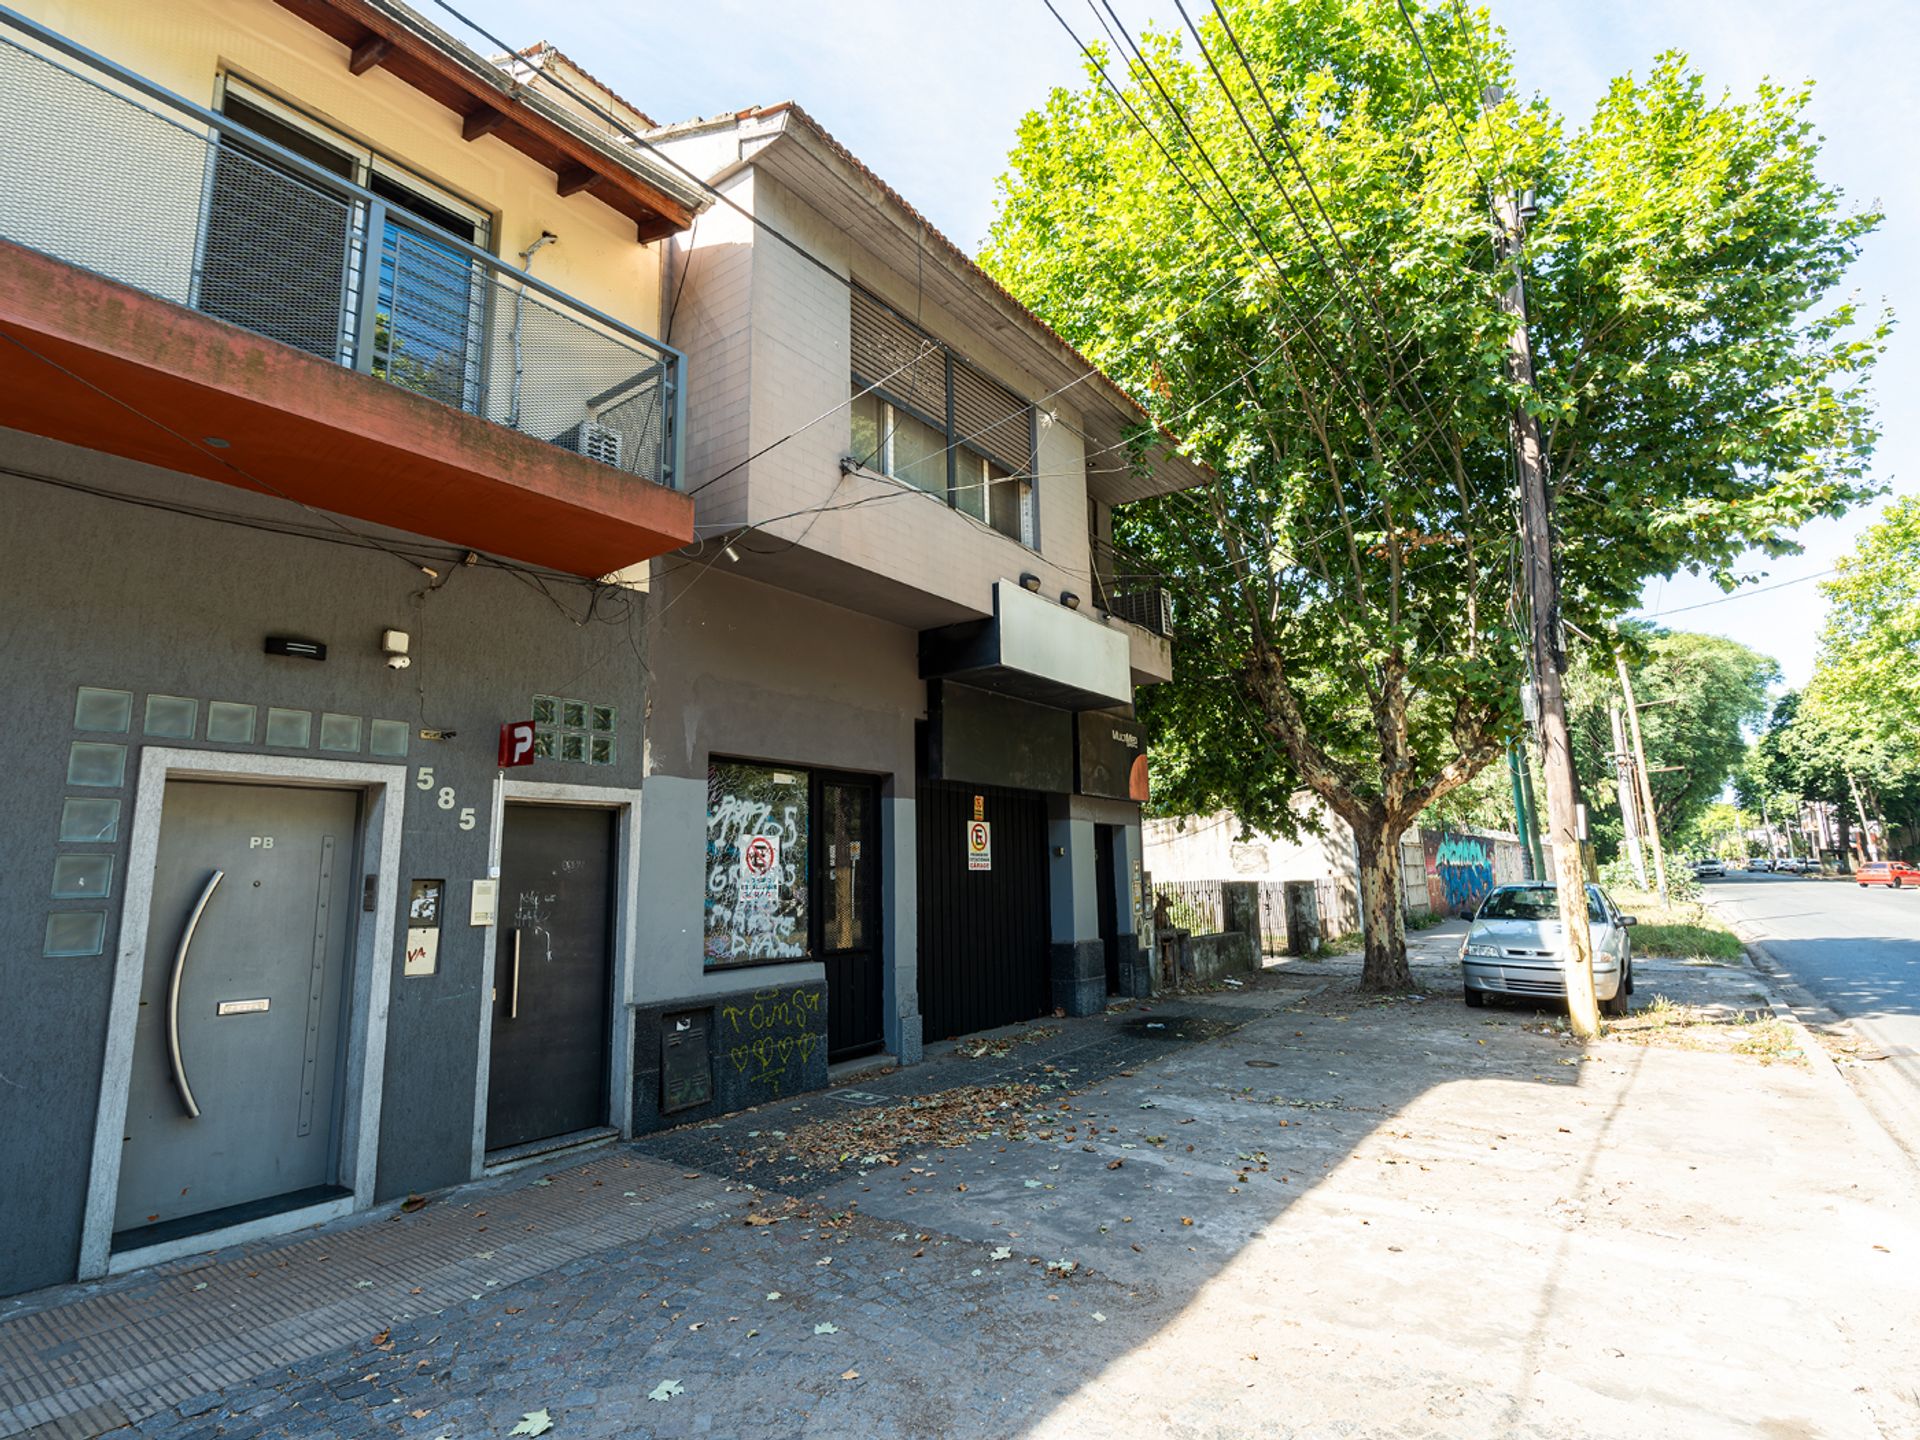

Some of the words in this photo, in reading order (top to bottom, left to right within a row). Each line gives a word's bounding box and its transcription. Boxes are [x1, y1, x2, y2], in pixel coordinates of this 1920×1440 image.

[513, 725, 533, 764] P
[416, 766, 477, 831] 585
[249, 836, 274, 849] PB
